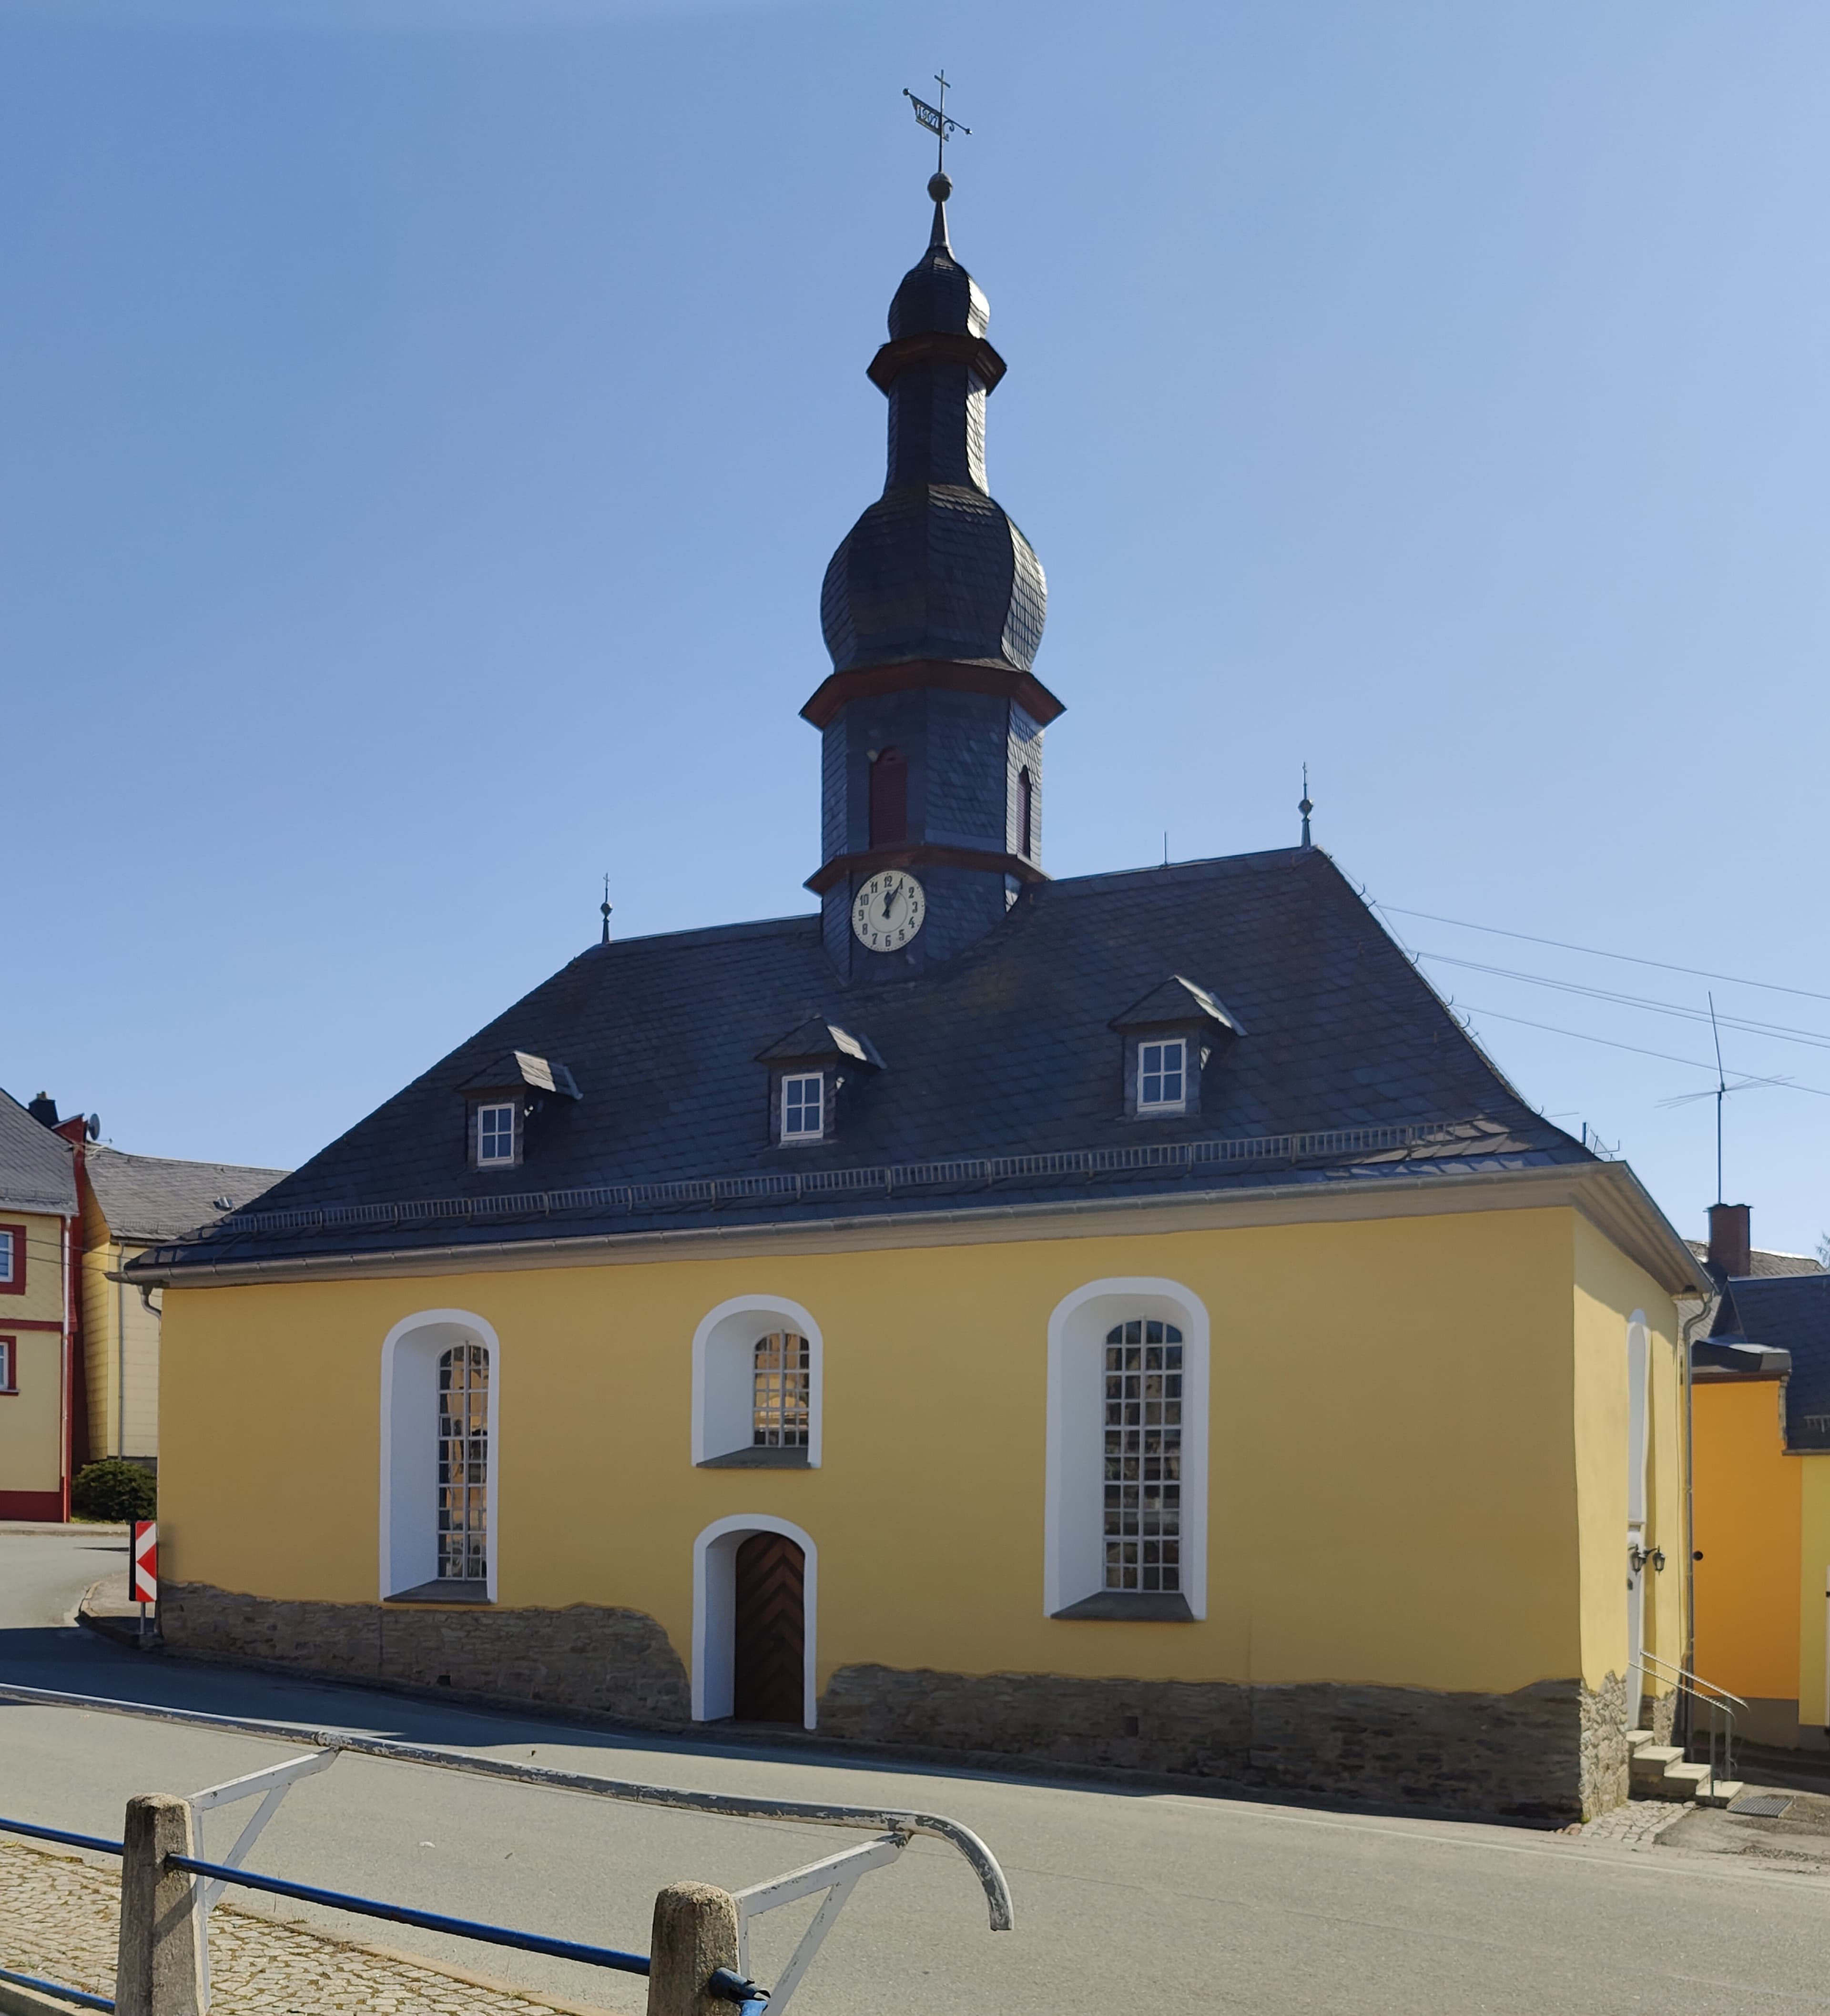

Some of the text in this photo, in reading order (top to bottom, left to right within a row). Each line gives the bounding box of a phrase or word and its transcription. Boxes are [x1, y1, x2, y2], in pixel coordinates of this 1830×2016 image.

[871, 881, 877, 893] 11
[884, 876, 892, 888] 12
[899, 878, 903, 890] 1
[909, 887, 915, 899] 2
[860, 894, 869, 906] 10
[912, 902, 918, 913] 3
[859, 910, 864, 921] 9
[908, 916, 915, 928] 4
[862, 923, 868, 935] 8
[899, 929, 905, 941] 5
[872, 933, 878, 945] 7
[885, 935, 891, 947] 6
